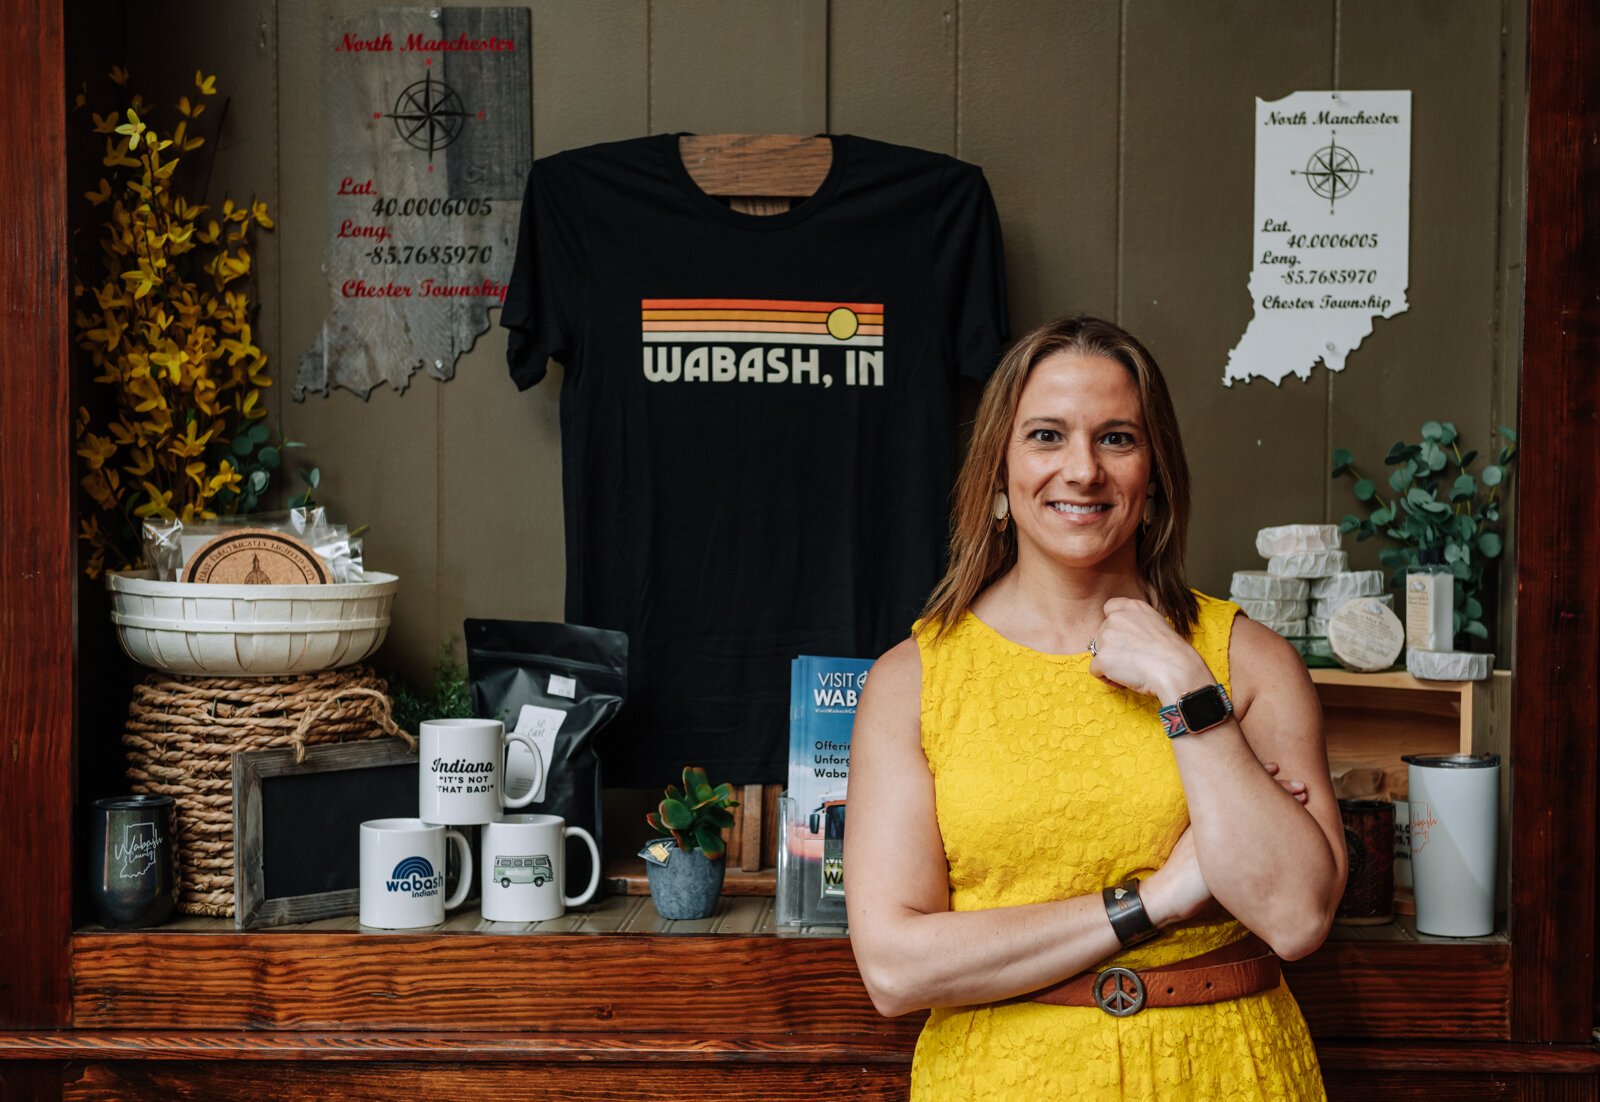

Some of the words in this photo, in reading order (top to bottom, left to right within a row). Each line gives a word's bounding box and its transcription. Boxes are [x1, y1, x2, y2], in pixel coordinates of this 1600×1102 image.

[336, 33, 393, 51] North
[400, 33, 516, 51] Manchester
[1264, 111, 1307, 125] North
[1312, 110, 1400, 125] Manchester
[336, 176, 378, 195] Lat.
[371, 197, 493, 217] 40.0006005
[337, 219, 393, 242] Long.
[1261, 218, 1292, 232] Lat.
[1287, 234, 1378, 249] 40.0006005
[365, 245, 493, 265] -85.7685970
[1260, 251, 1302, 267] Long.
[1281, 270, 1377, 284] -85.7685970
[341, 279, 412, 299] Chester
[1262, 295, 1315, 310] Chester
[1319, 294, 1391, 312] Township
[643, 346, 833, 388] WABASH,
[846, 350, 884, 386] IN
[818, 672, 854, 688] VISIT
[431, 757, 495, 773] Indiana
[468, 775, 489, 783] NOT
[436, 785, 463, 793] THAT
[114, 828, 163, 860] Wabash
[386, 870, 443, 892] wabash
[412, 889, 438, 898] indiana
